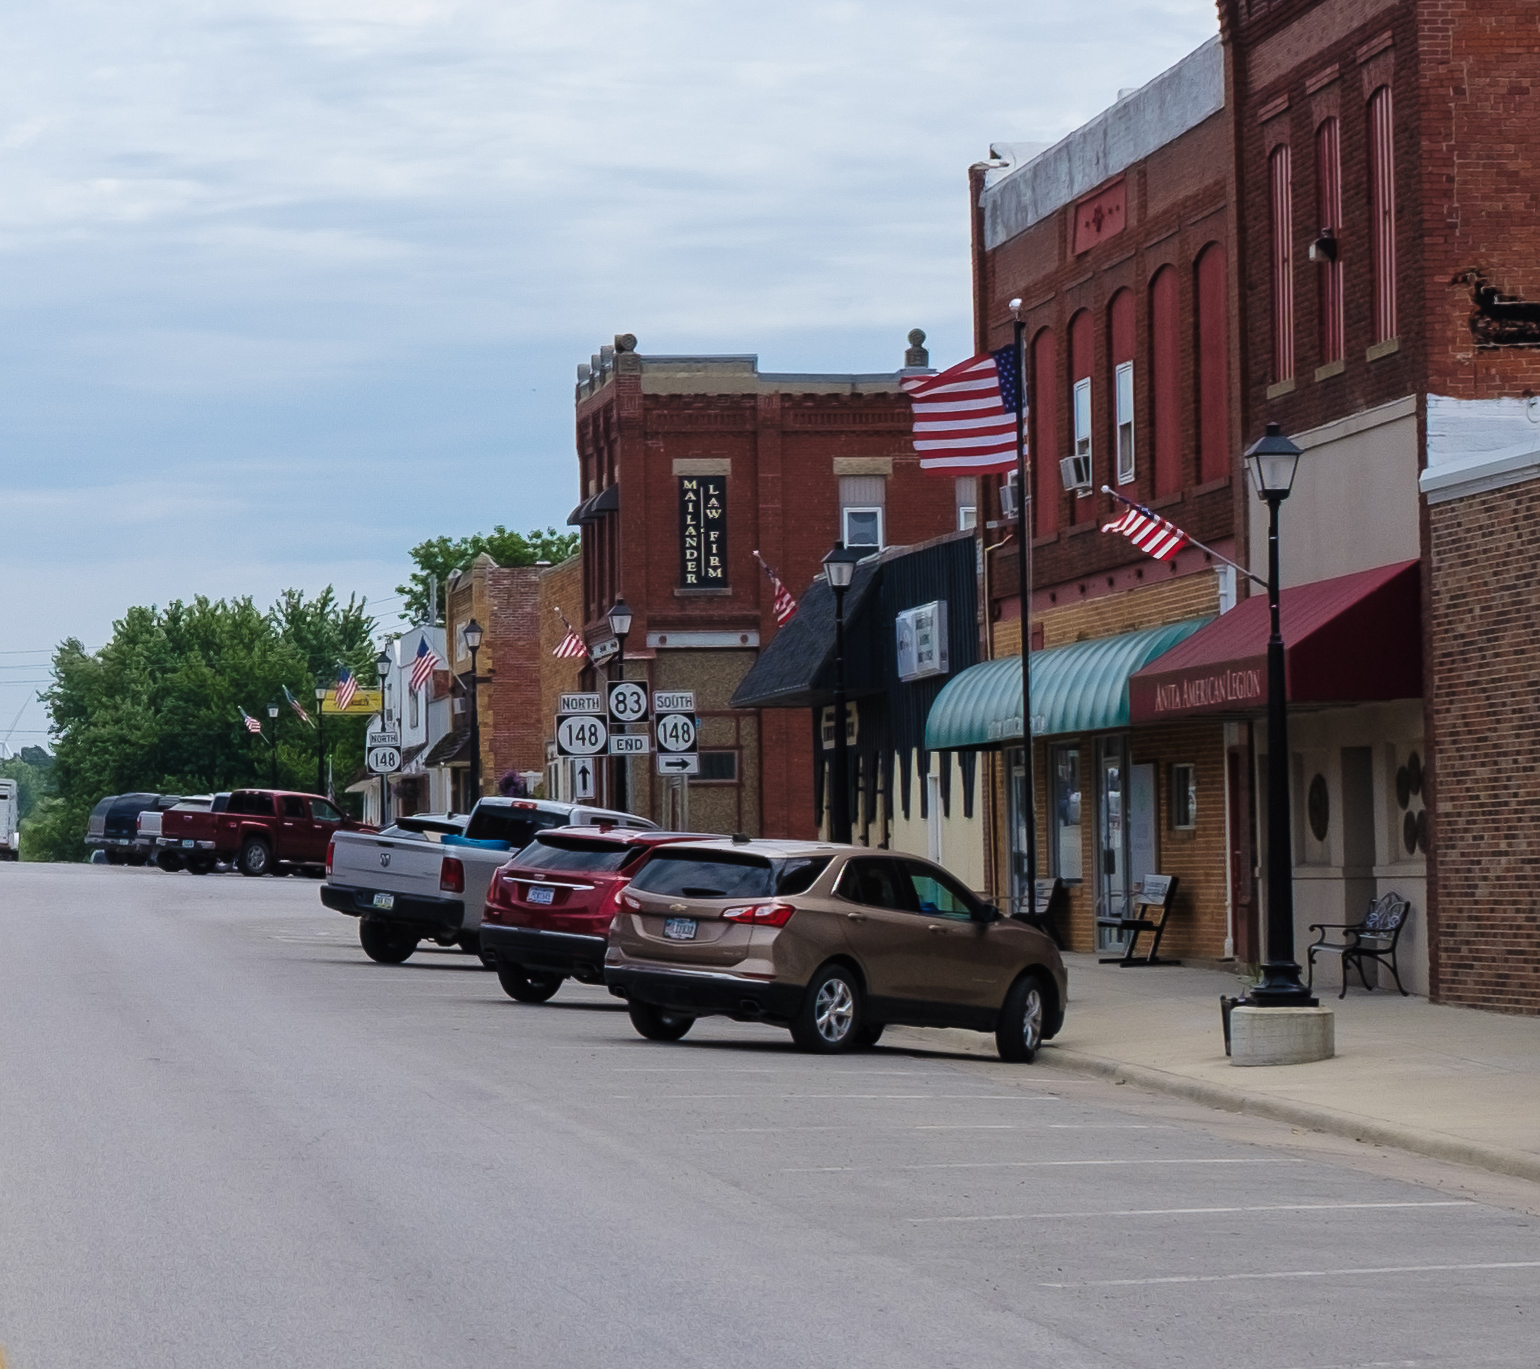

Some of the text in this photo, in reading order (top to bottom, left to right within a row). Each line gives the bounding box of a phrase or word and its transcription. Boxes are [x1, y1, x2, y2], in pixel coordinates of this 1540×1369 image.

[683, 479, 698, 584] MAILANDER
[705, 484, 723, 578] LAW FIRM
[656, 695, 692, 709] SOUTH
[1154, 670, 1261, 711] ANITA AMERICAN LEGION
[562, 696, 599, 710] NORTH
[614, 691, 642, 714] 83
[371, 734, 397, 743] NORTH
[567, 723, 599, 747] 148
[661, 721, 691, 744] 148
[617, 738, 643, 751] END
[375, 751, 396, 768] 148
